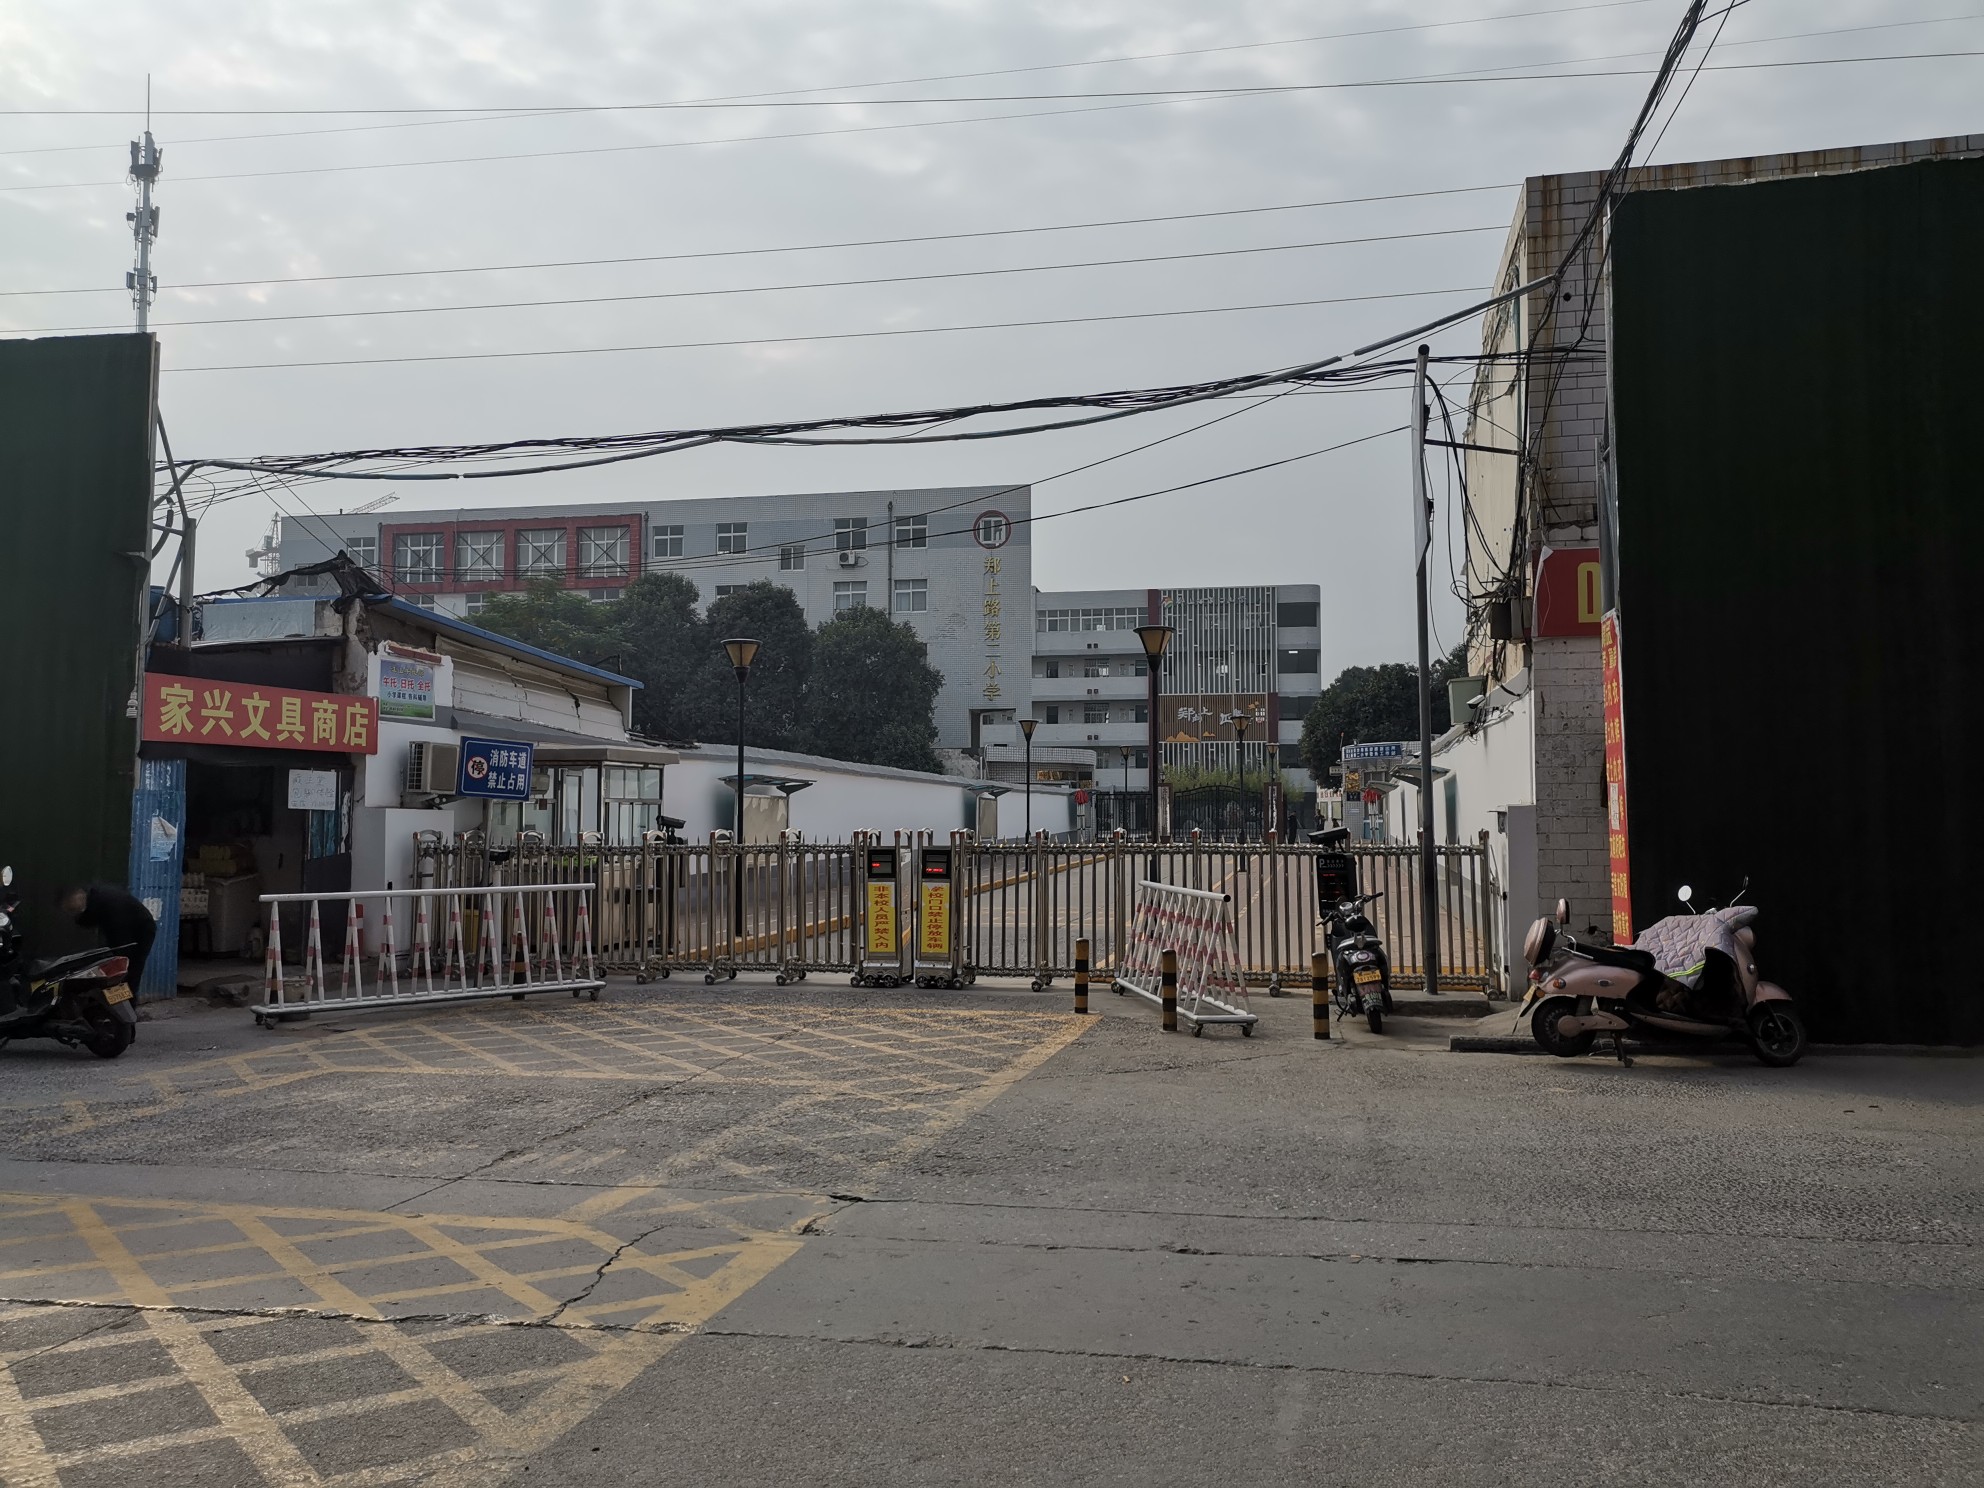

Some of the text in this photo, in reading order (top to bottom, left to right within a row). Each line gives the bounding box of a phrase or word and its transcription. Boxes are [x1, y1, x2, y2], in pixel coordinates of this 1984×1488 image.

[983, 556, 1001, 701] 郑上路第二小学
[383, 677, 431, 692] 午托 日托 全托
[159, 684, 369, 746] 家兴文具商店
[471, 760, 485, 775] 停
[489, 749, 527, 770] 消防车道
[487, 771, 525, 791] 禁止占用
[874, 886, 889, 948] 非本校人员严禁入内
[927, 886, 943, 949] 学校门口禁止停放车辆
